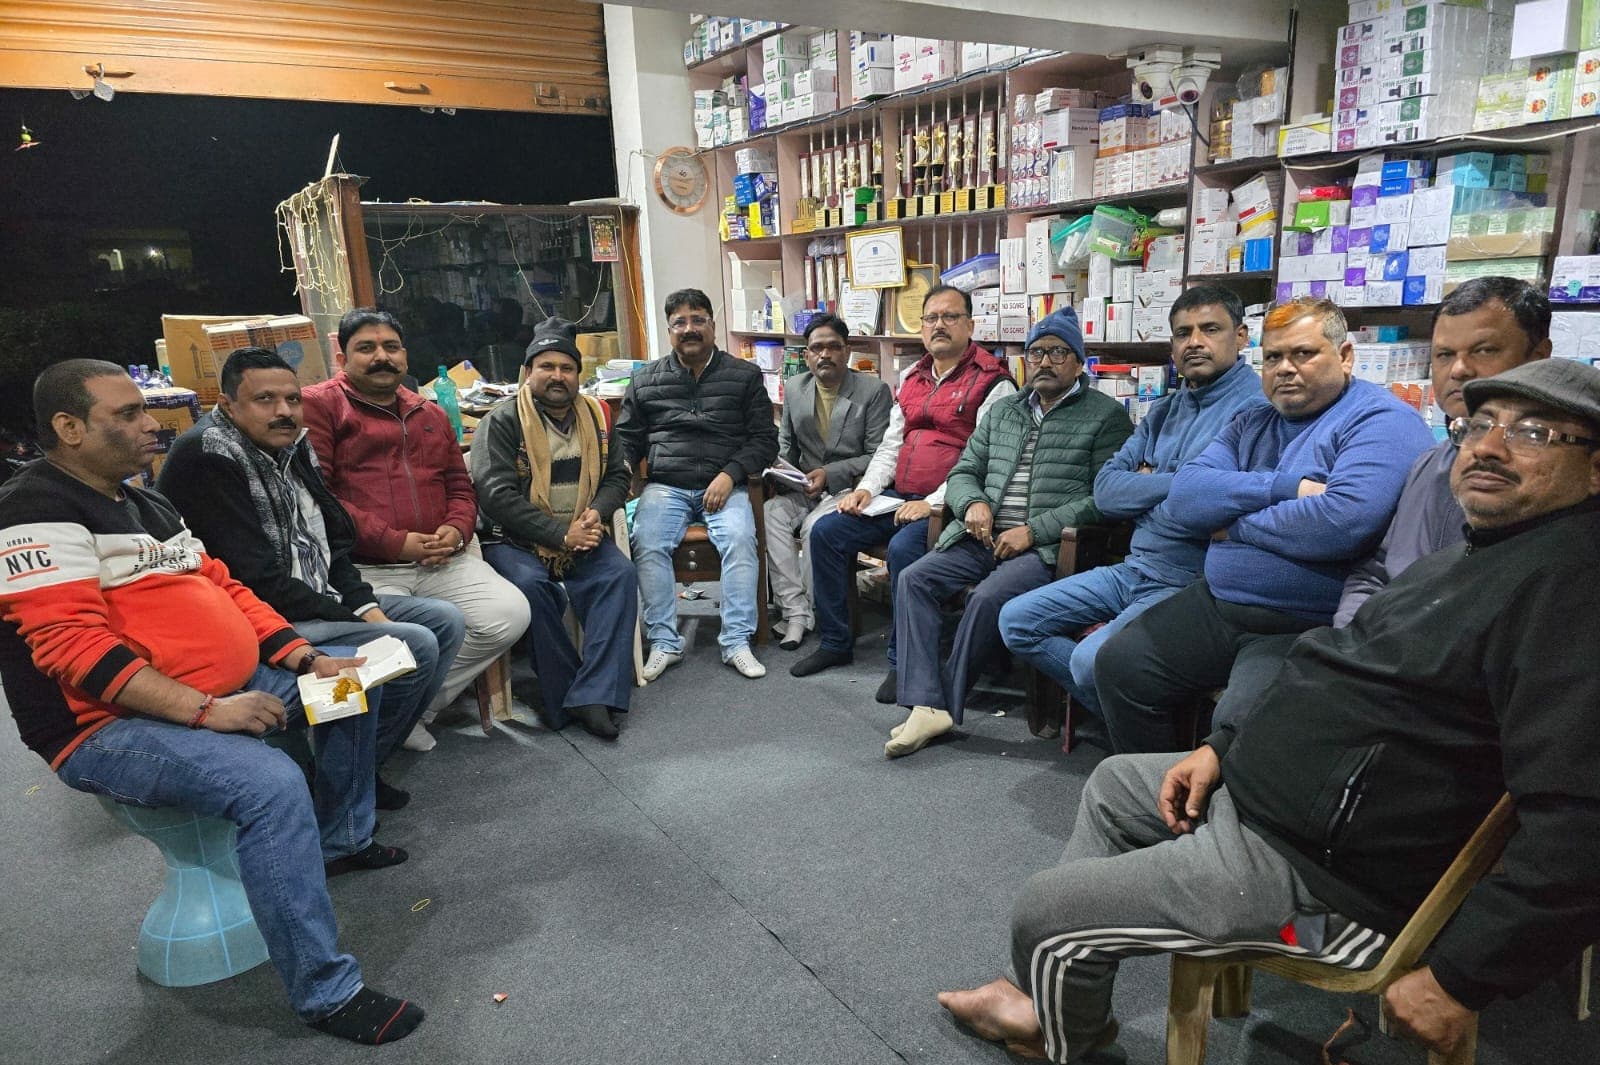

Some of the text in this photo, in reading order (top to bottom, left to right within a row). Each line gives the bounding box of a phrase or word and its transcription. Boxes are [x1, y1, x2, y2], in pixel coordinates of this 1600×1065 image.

[1009, 302, 1025, 310] SCARS
[6, 536, 33, 548] URBAN
[5, 550, 51, 575] NYC
